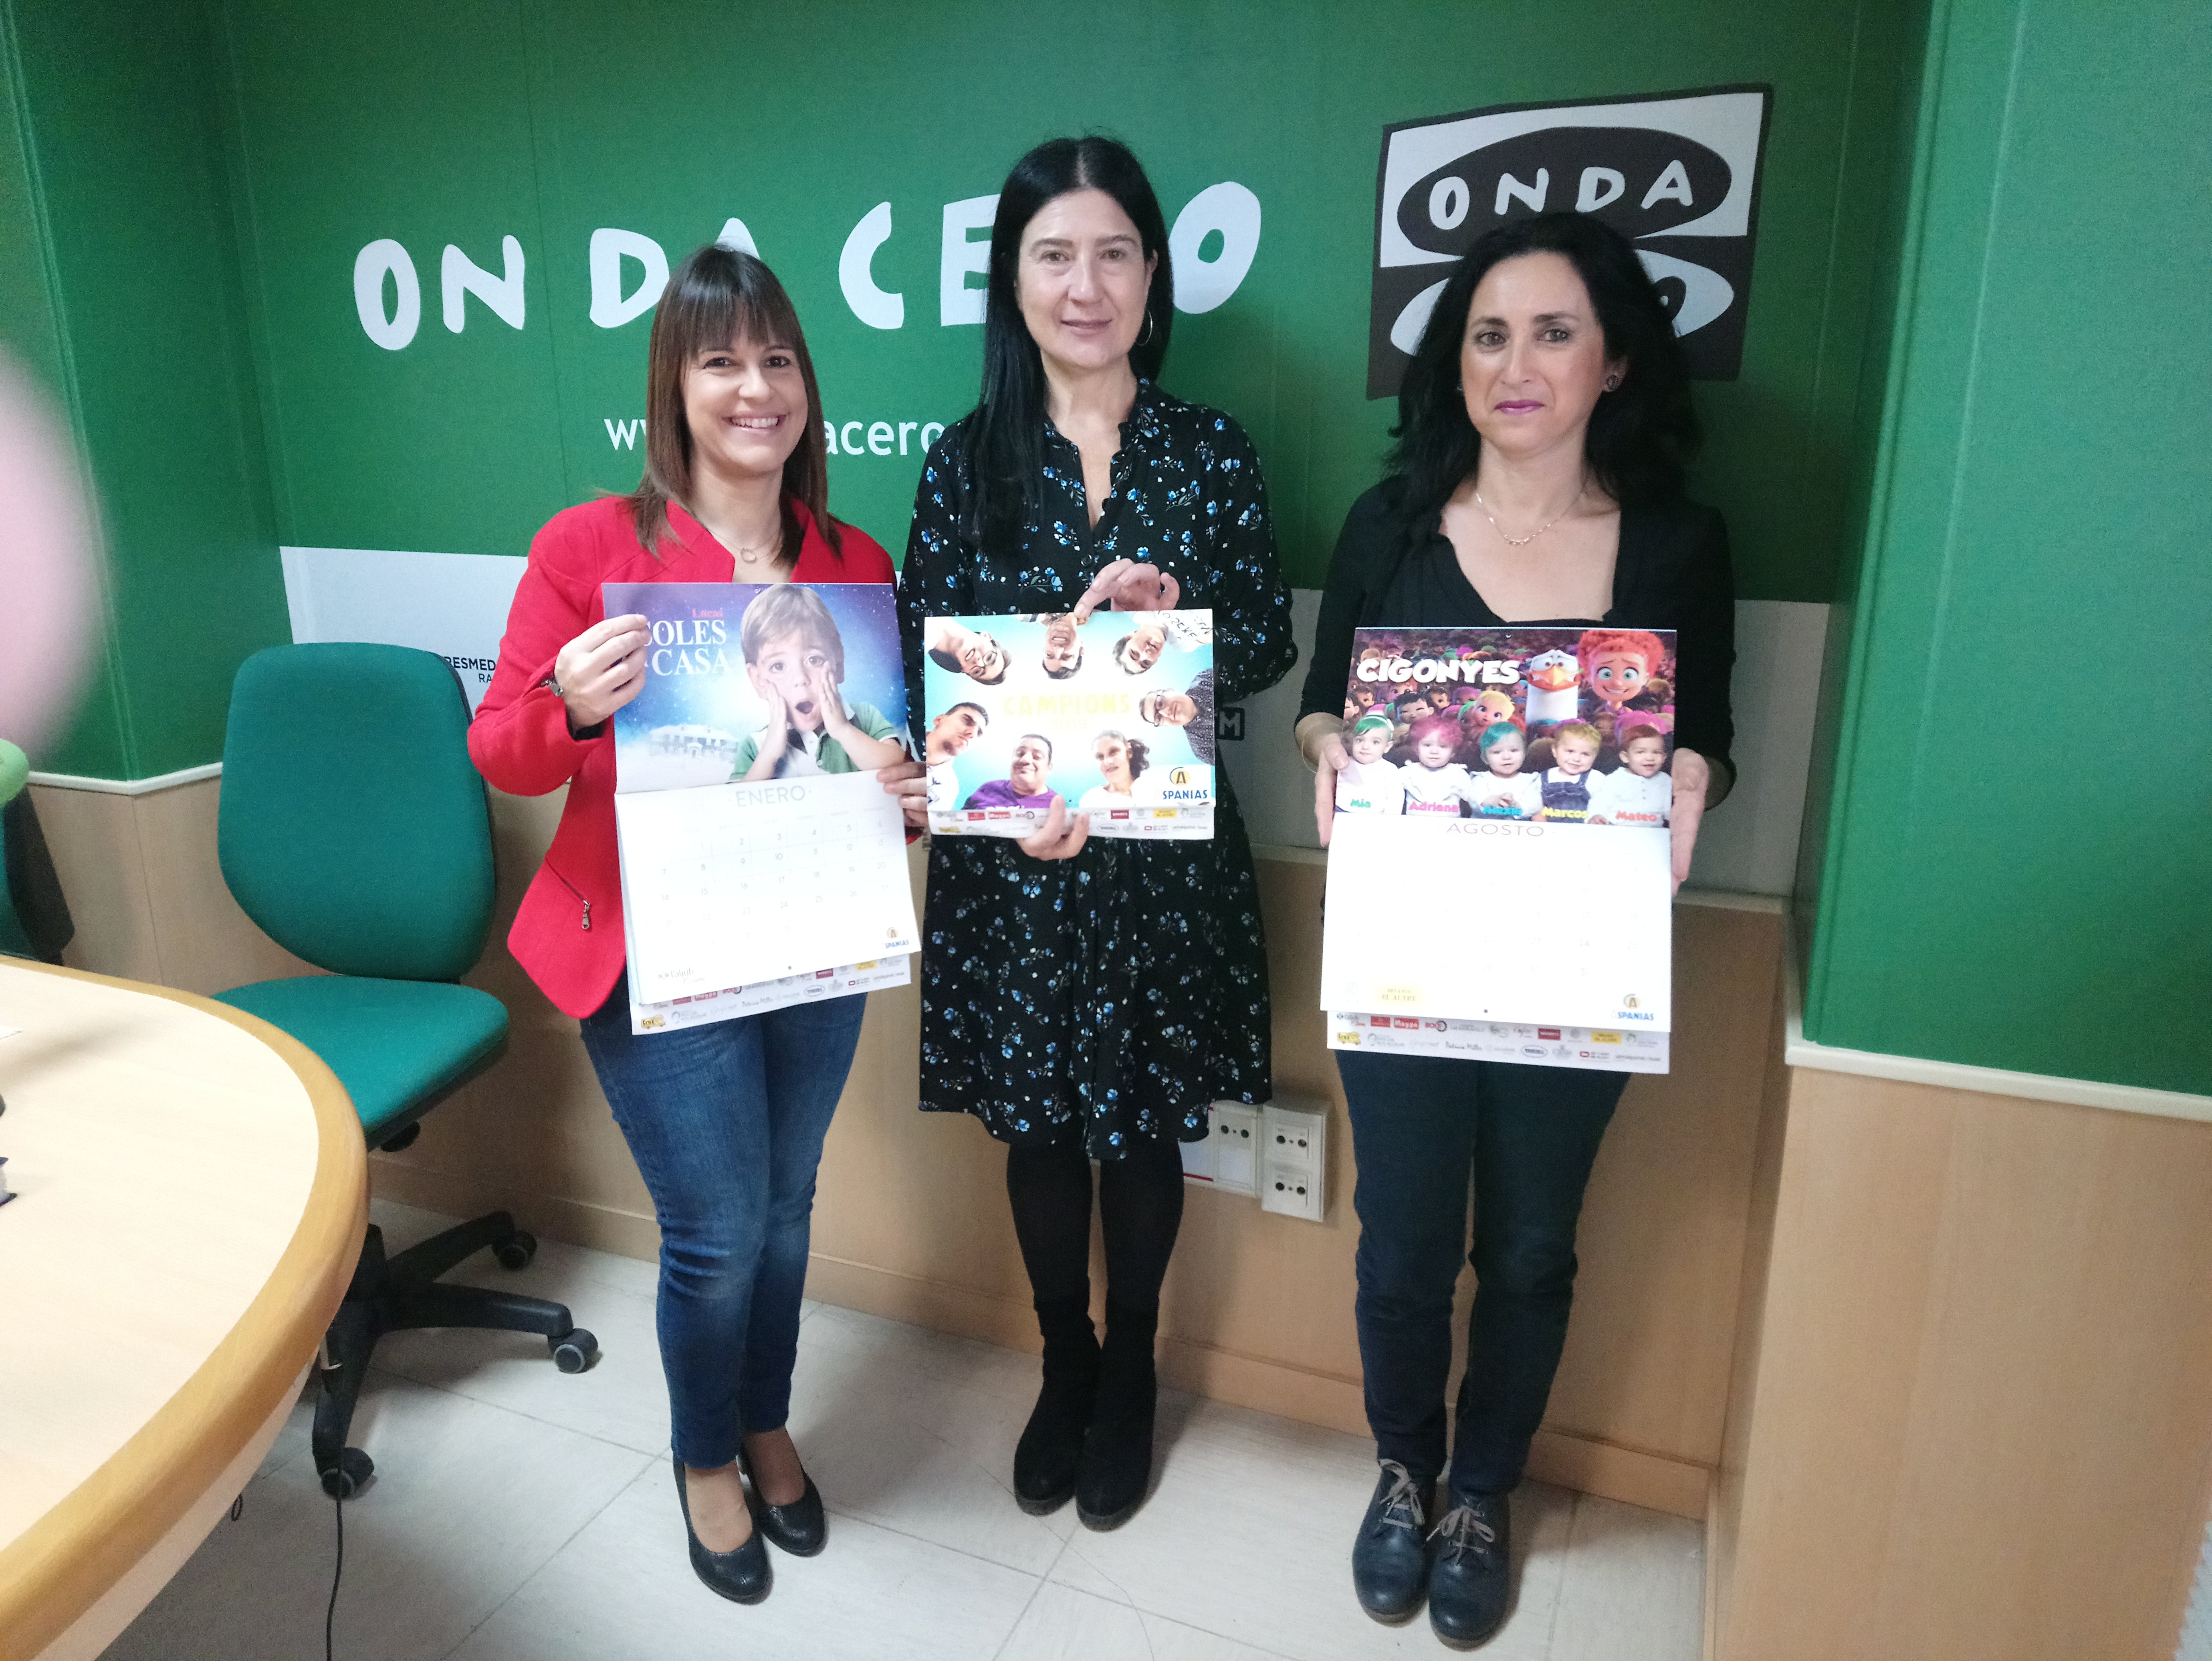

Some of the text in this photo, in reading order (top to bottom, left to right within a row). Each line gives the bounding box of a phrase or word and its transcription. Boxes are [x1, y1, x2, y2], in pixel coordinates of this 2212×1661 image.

[1429, 160, 1693, 230] ONDA
[838, 181, 1261, 329] CEO
[652, 648, 729, 676] CASA
[1356, 658, 1520, 685] CIGONYES
[1003, 693, 1130, 715] CAMPIONS
[735, 785, 805, 807] ENERO
[1409, 801, 1459, 812] Adriana
[1542, 806, 1588, 818] Marcos
[1616, 811, 1657, 822] Mateo
[1446, 823, 1544, 837] AGOSTO
[775, 853, 783, 861] 10
[701, 887, 708, 895] 15
[743, 906, 751, 915] 23
[815, 895, 823, 903] 25
